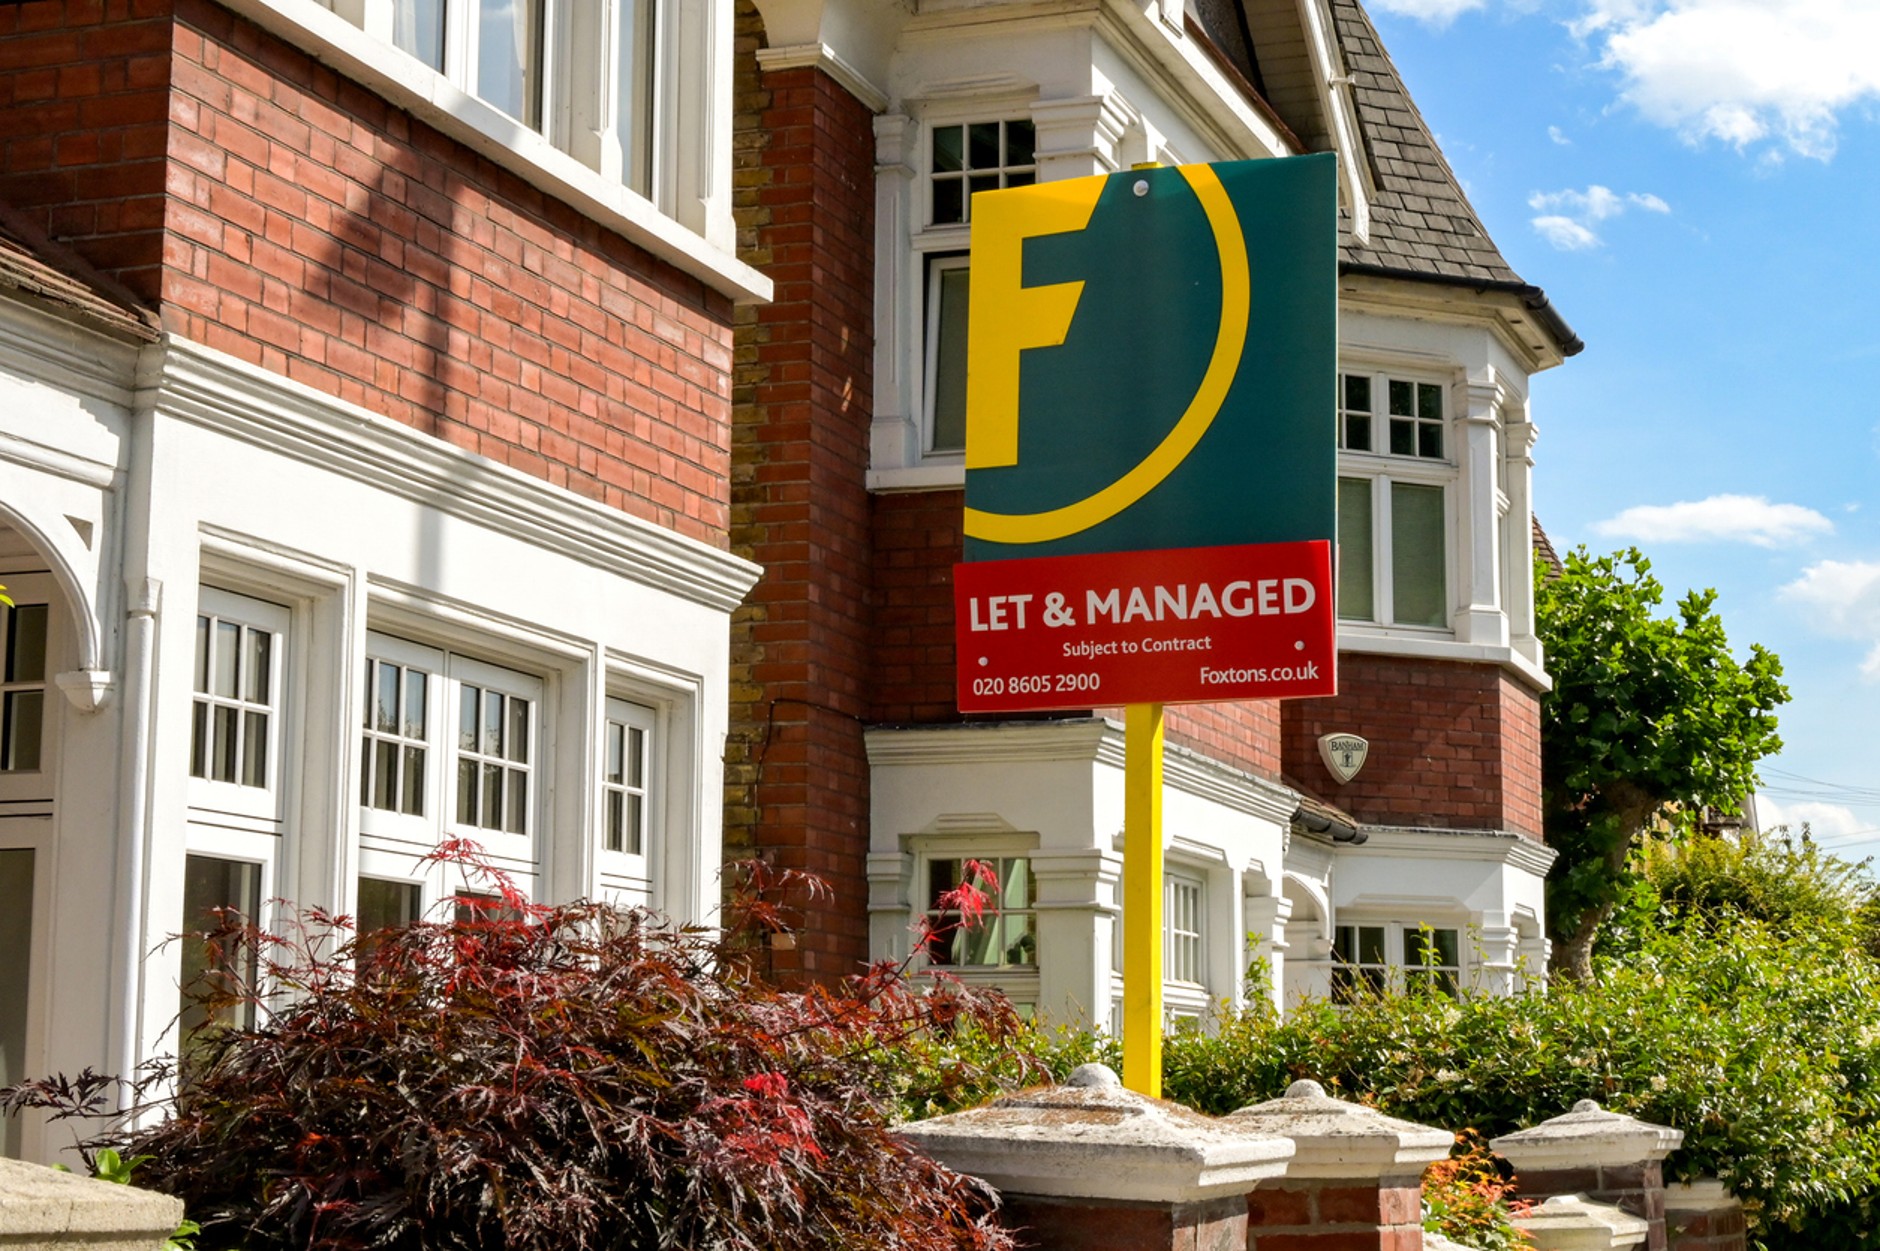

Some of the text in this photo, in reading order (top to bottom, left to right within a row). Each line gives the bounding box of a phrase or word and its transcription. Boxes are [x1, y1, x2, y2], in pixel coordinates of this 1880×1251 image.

[966, 174, 1109, 468] F
[970, 578, 1315, 631] LET & MANAGED
[1063, 637, 1211, 659] Subject to Contract
[973, 673, 1100, 695] 020 8605 2900
[1201, 661, 1318, 684] Foxtons.co.uk
